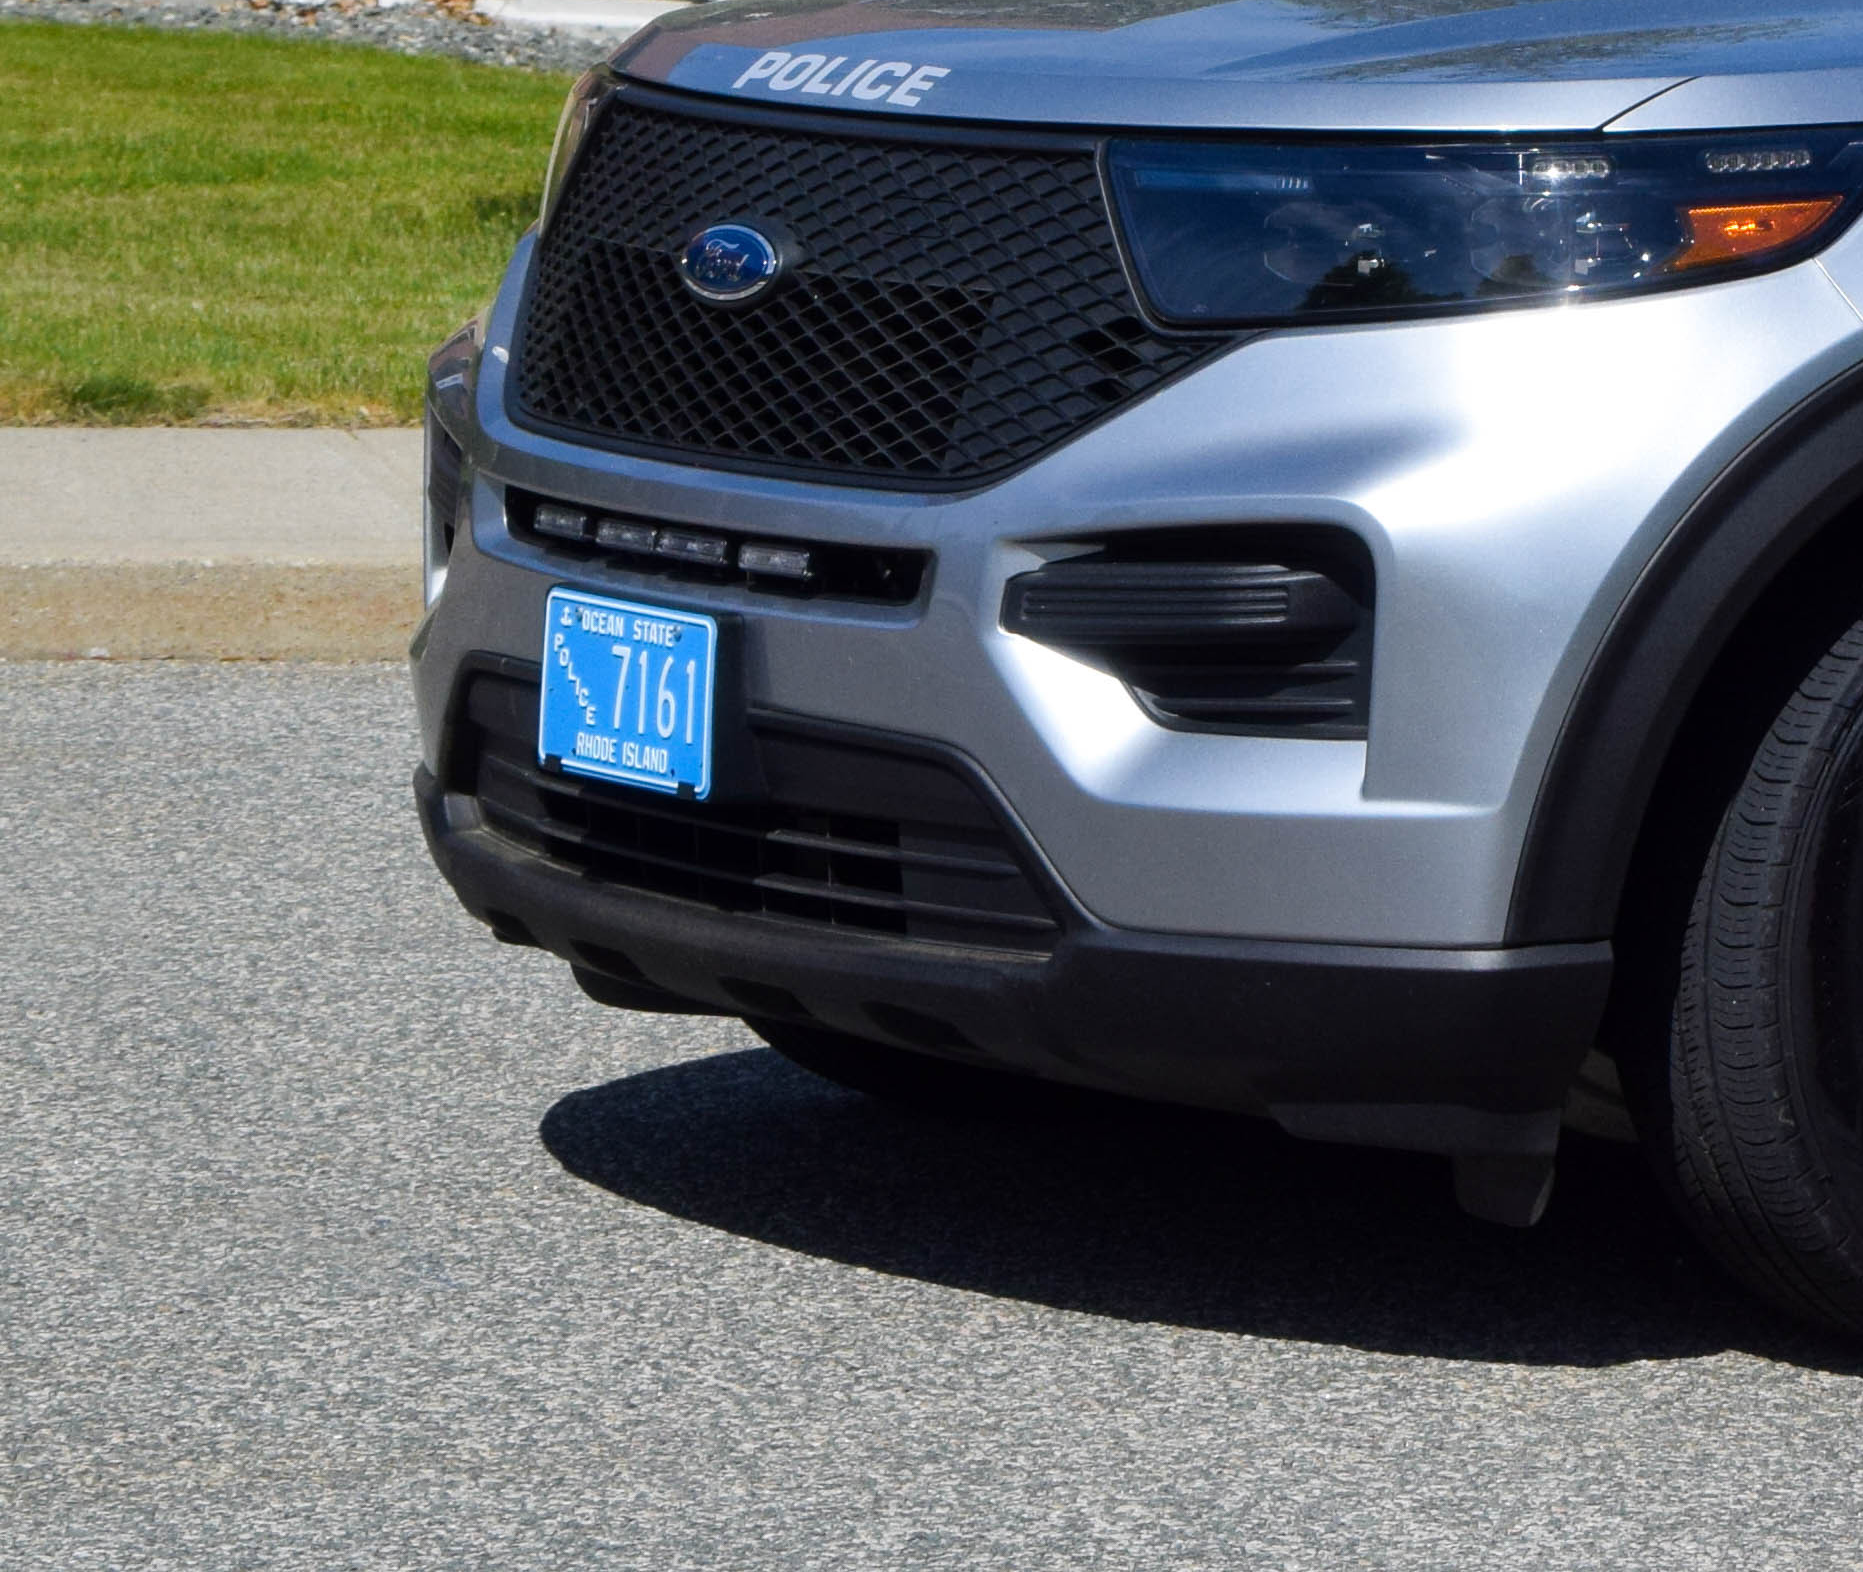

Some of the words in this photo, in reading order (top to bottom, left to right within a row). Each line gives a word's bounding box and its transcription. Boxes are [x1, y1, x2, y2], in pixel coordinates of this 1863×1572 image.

[732, 51, 951, 107] POLICE
[582, 609, 624, 638] OCEAN
[633, 619, 676, 648] STATE
[612, 644, 696, 744] 7161
[576, 731, 617, 763] RHODE
[622, 741, 668, 774] ISLAND
